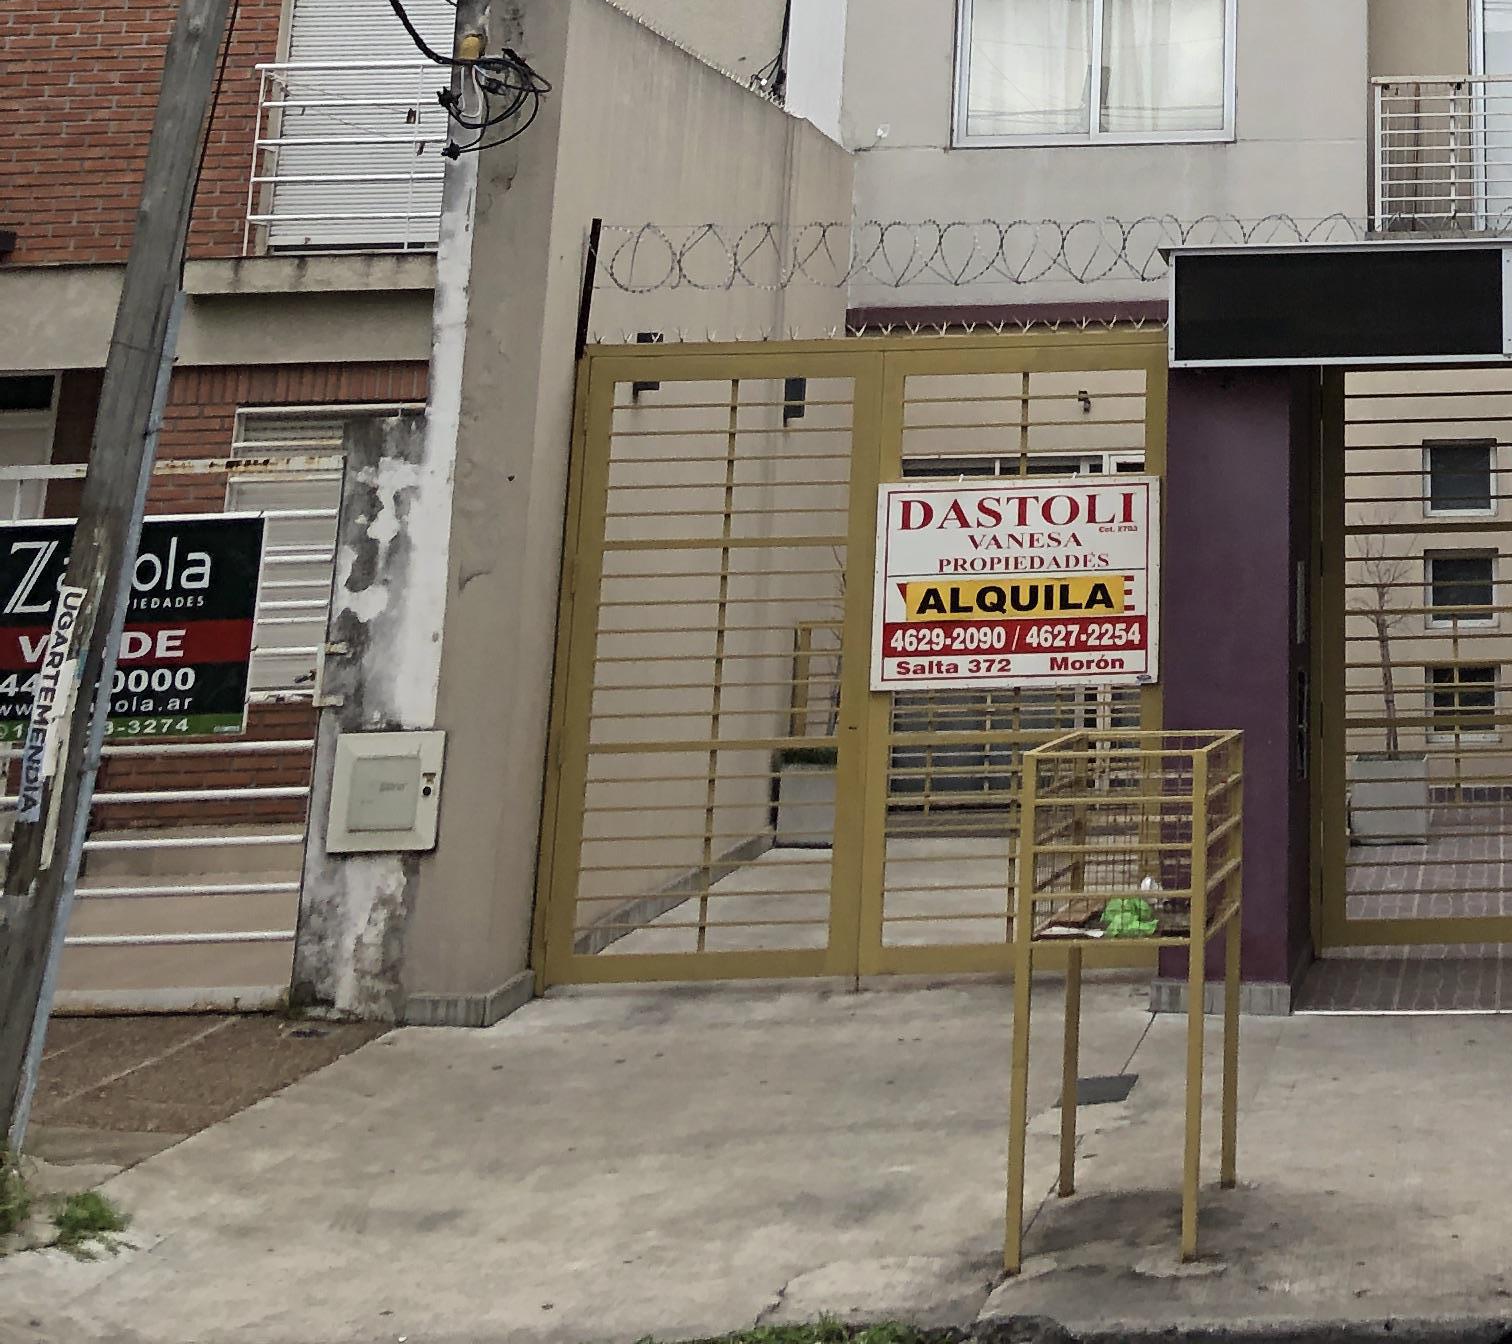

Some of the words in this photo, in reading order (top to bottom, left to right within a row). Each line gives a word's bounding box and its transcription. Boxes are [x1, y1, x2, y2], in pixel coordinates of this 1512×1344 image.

[897, 492, 1135, 530] DASTOLI
[967, 532, 1083, 551] VANESA
[938, 552, 1111, 573] PROPIEDADES
[916, 582, 1115, 615] ALQUILA
[18, 629, 187, 663] VDE
[890, 626, 1006, 652] 4629-2090
[1026, 623, 1141, 648] 4627-2254
[896, 660, 960, 676] Salta
[967, 658, 1012, 674] 372
[1050, 656, 1125, 672] Morón
[20, 591, 84, 812] UGARTEMENDIA
